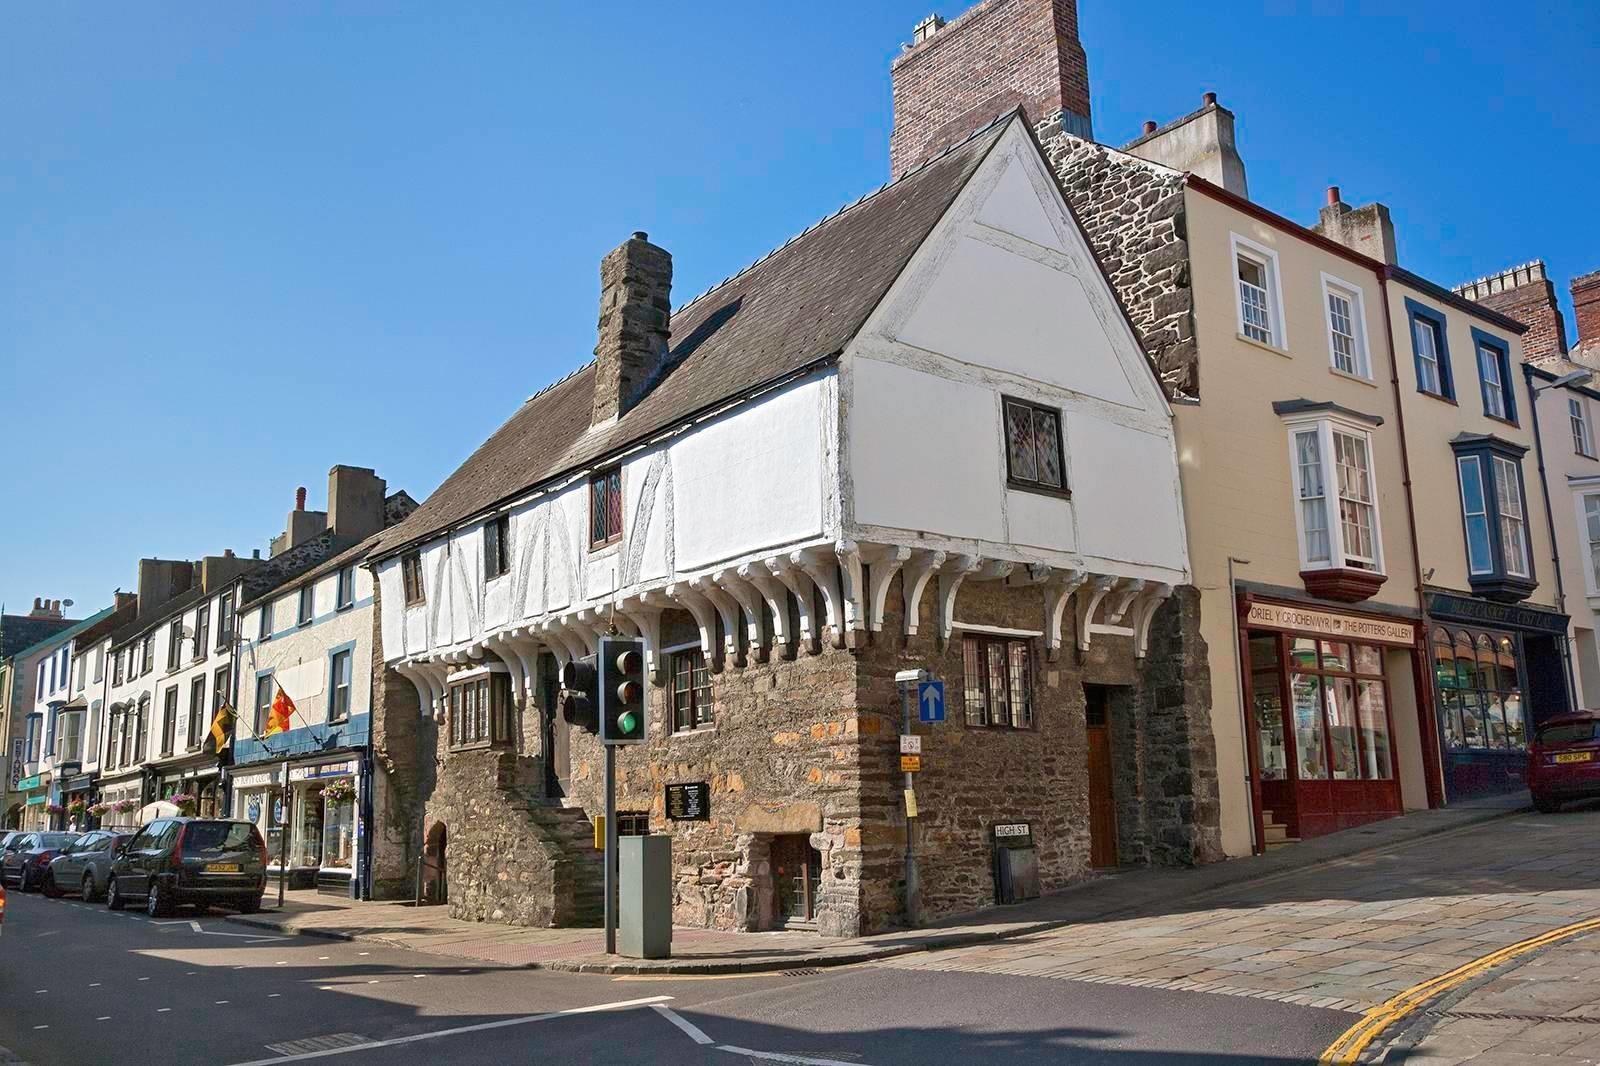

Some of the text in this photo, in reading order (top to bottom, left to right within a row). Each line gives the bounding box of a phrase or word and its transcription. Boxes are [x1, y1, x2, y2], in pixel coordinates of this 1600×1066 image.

[1250, 607, 1330, 628] ORIEL Y CROCHENWYR
[1344, 620, 1413, 639] THE POTTERS GALLERY
[997, 826, 1015, 835] HIGH
